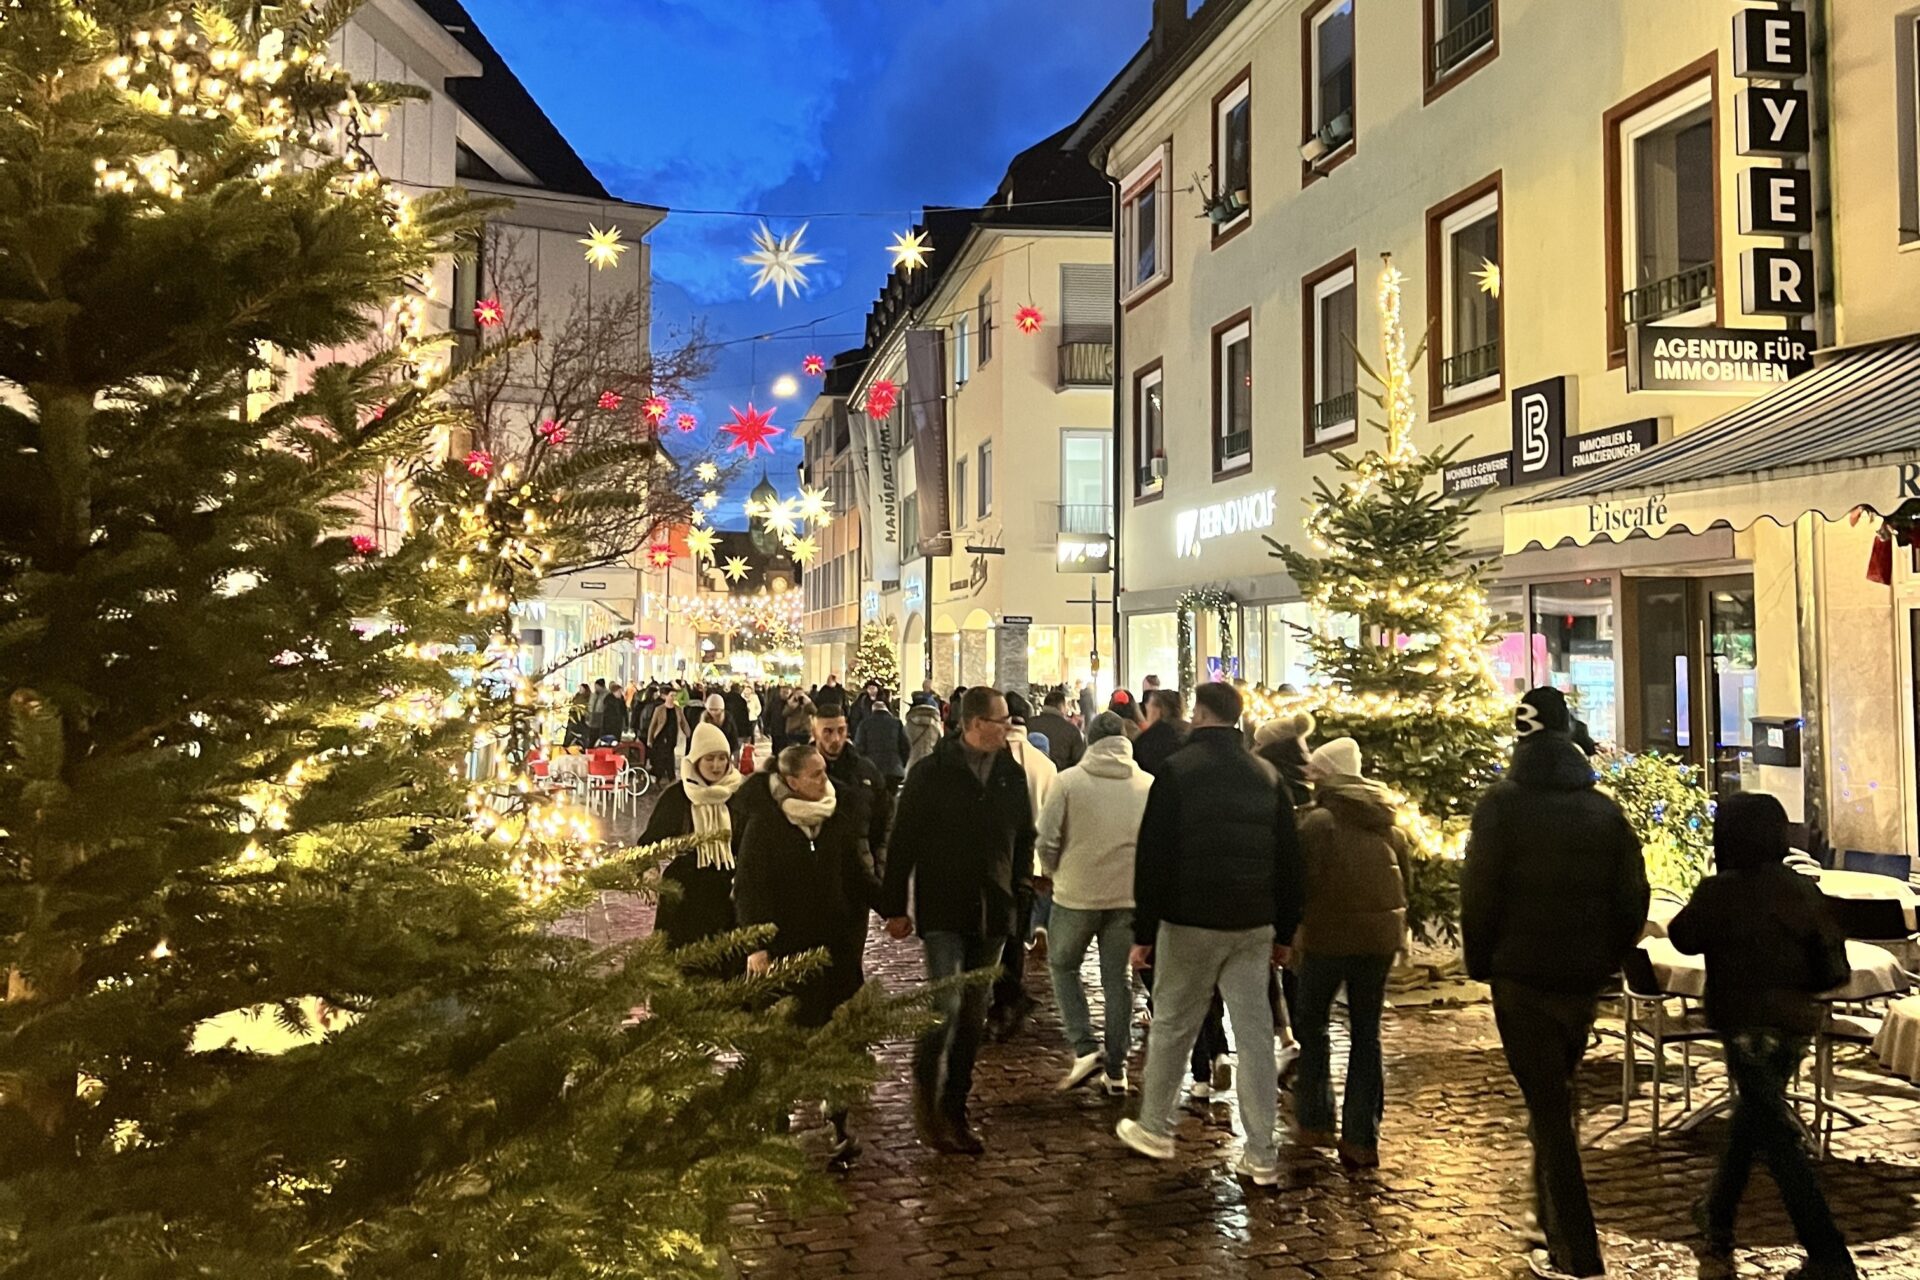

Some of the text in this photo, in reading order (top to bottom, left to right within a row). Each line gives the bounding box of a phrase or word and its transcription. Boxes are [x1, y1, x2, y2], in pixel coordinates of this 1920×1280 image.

[1653, 336, 1806, 361] AGENTUR FÜR
[1654, 360, 1789, 383] IMMOBILIEN
[1579, 431, 1626, 453] IMMOBILIEN
[1572, 443, 1641, 468] FINANZIERUNGEN
[1445, 466, 1472, 481] WOHNEN
[1477, 457, 1508, 474] GEWERBE
[1460, 472, 1498, 490] INVESTMENT
[1237, 488, 1277, 533] WOLF
[1588, 493, 1668, 532] Eiscafé
